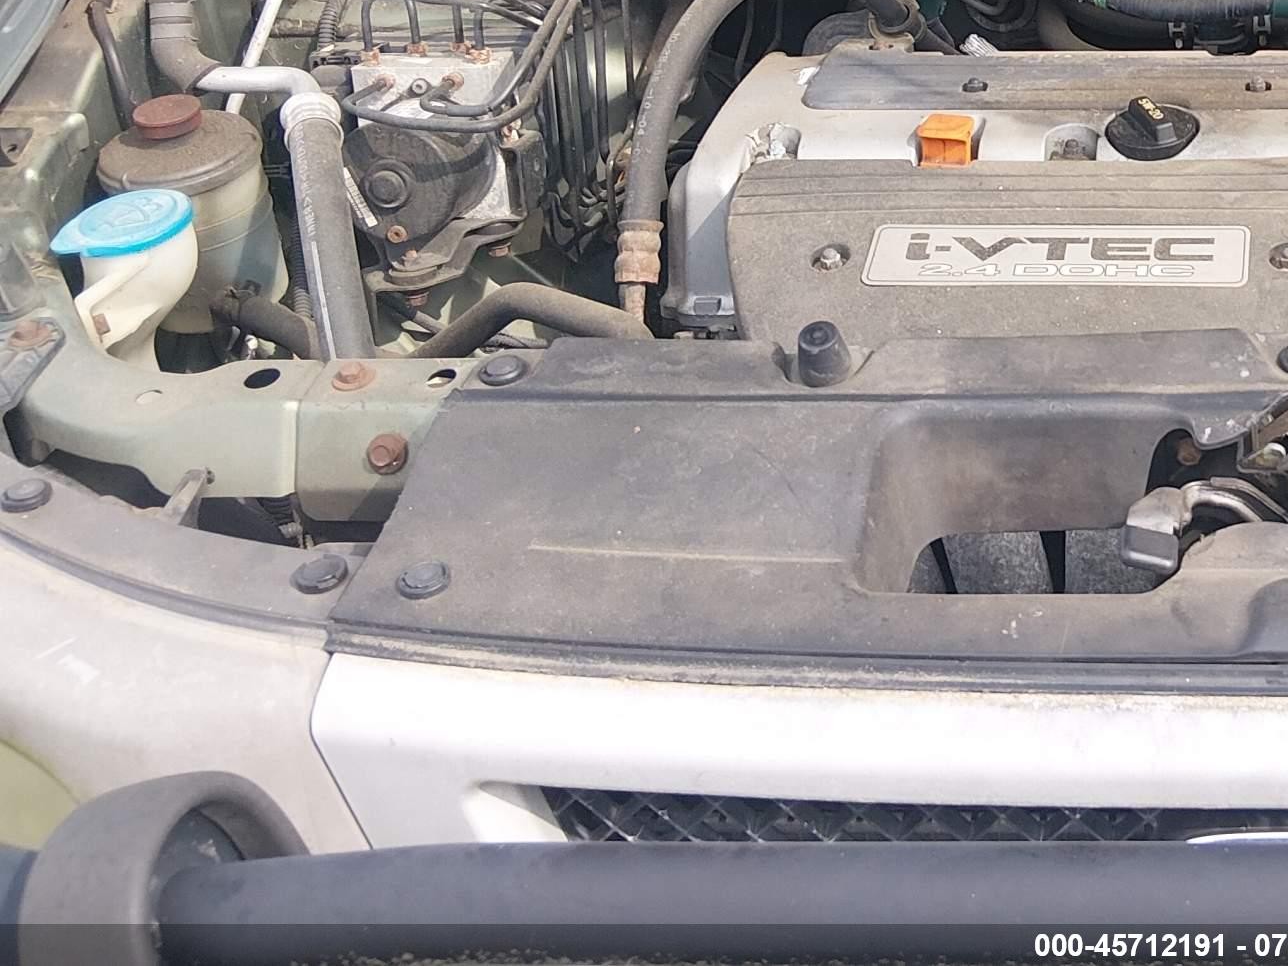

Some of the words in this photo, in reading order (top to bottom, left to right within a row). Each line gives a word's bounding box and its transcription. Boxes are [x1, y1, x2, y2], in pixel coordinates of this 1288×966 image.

[1138, 98, 1164, 119] 5W-20
[905, 232, 1216, 262] i-VTEC
[918, 262, 1001, 277] 2.4
[1012, 263, 1195, 278] DOHC
